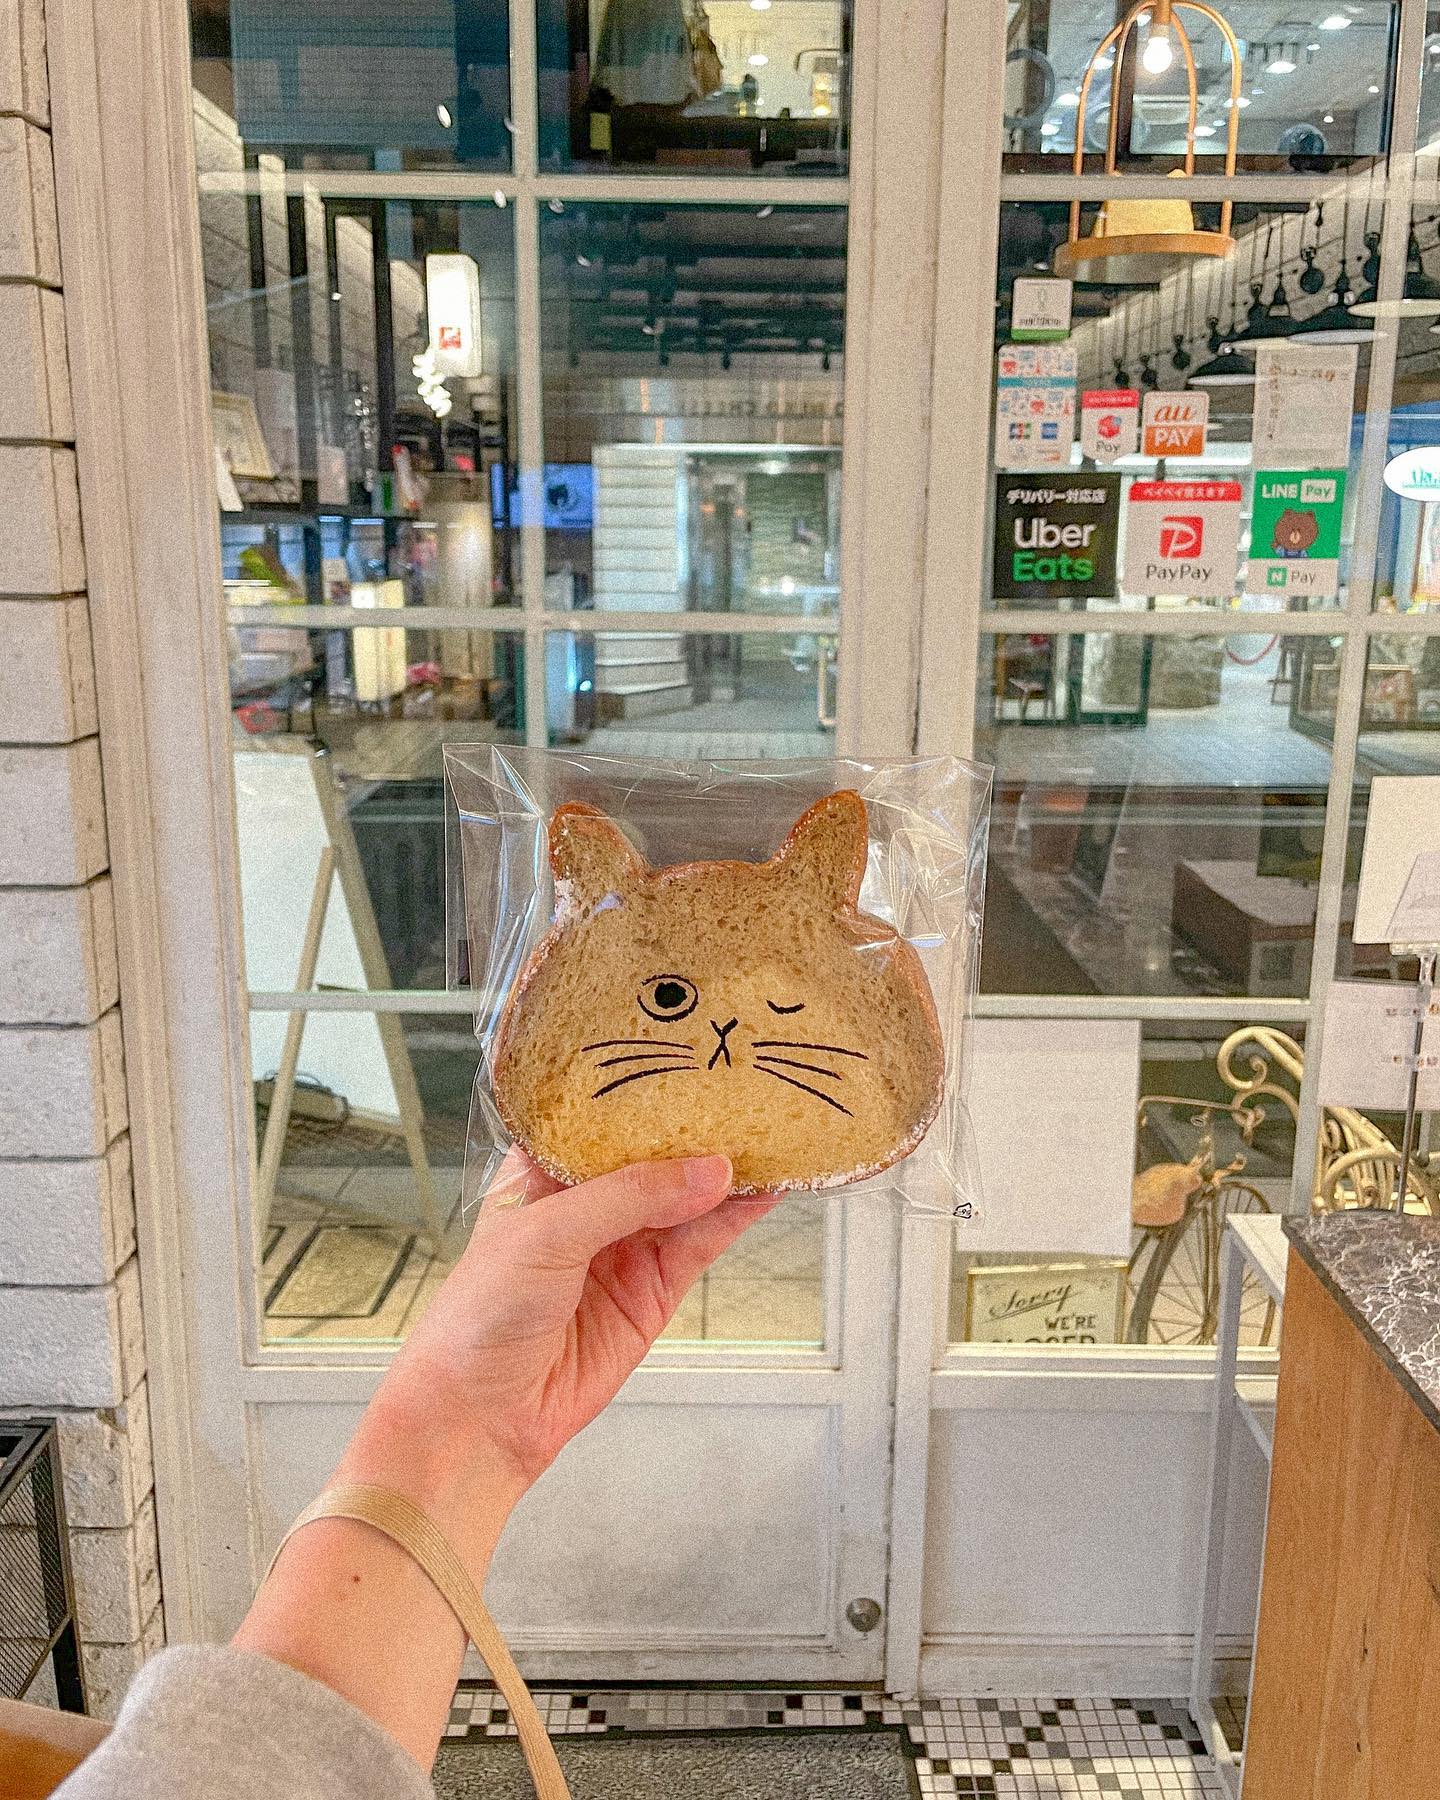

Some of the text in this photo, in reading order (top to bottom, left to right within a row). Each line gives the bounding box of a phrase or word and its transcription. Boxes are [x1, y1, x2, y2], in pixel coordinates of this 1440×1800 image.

[1154, 405, 1195, 422] au
[1155, 427, 1195, 448] PAY
[1262, 483, 1332, 499] LINE Pay
[1015, 517, 1097, 549] Uber
[1013, 551, 1093, 581] Eats
[1146, 563, 1212, 581] PayPay
[1291, 570, 1317, 586] Pay
[988, 1284, 1072, 1317] Sorry
[1045, 1313, 1097, 1331] WE'RE
